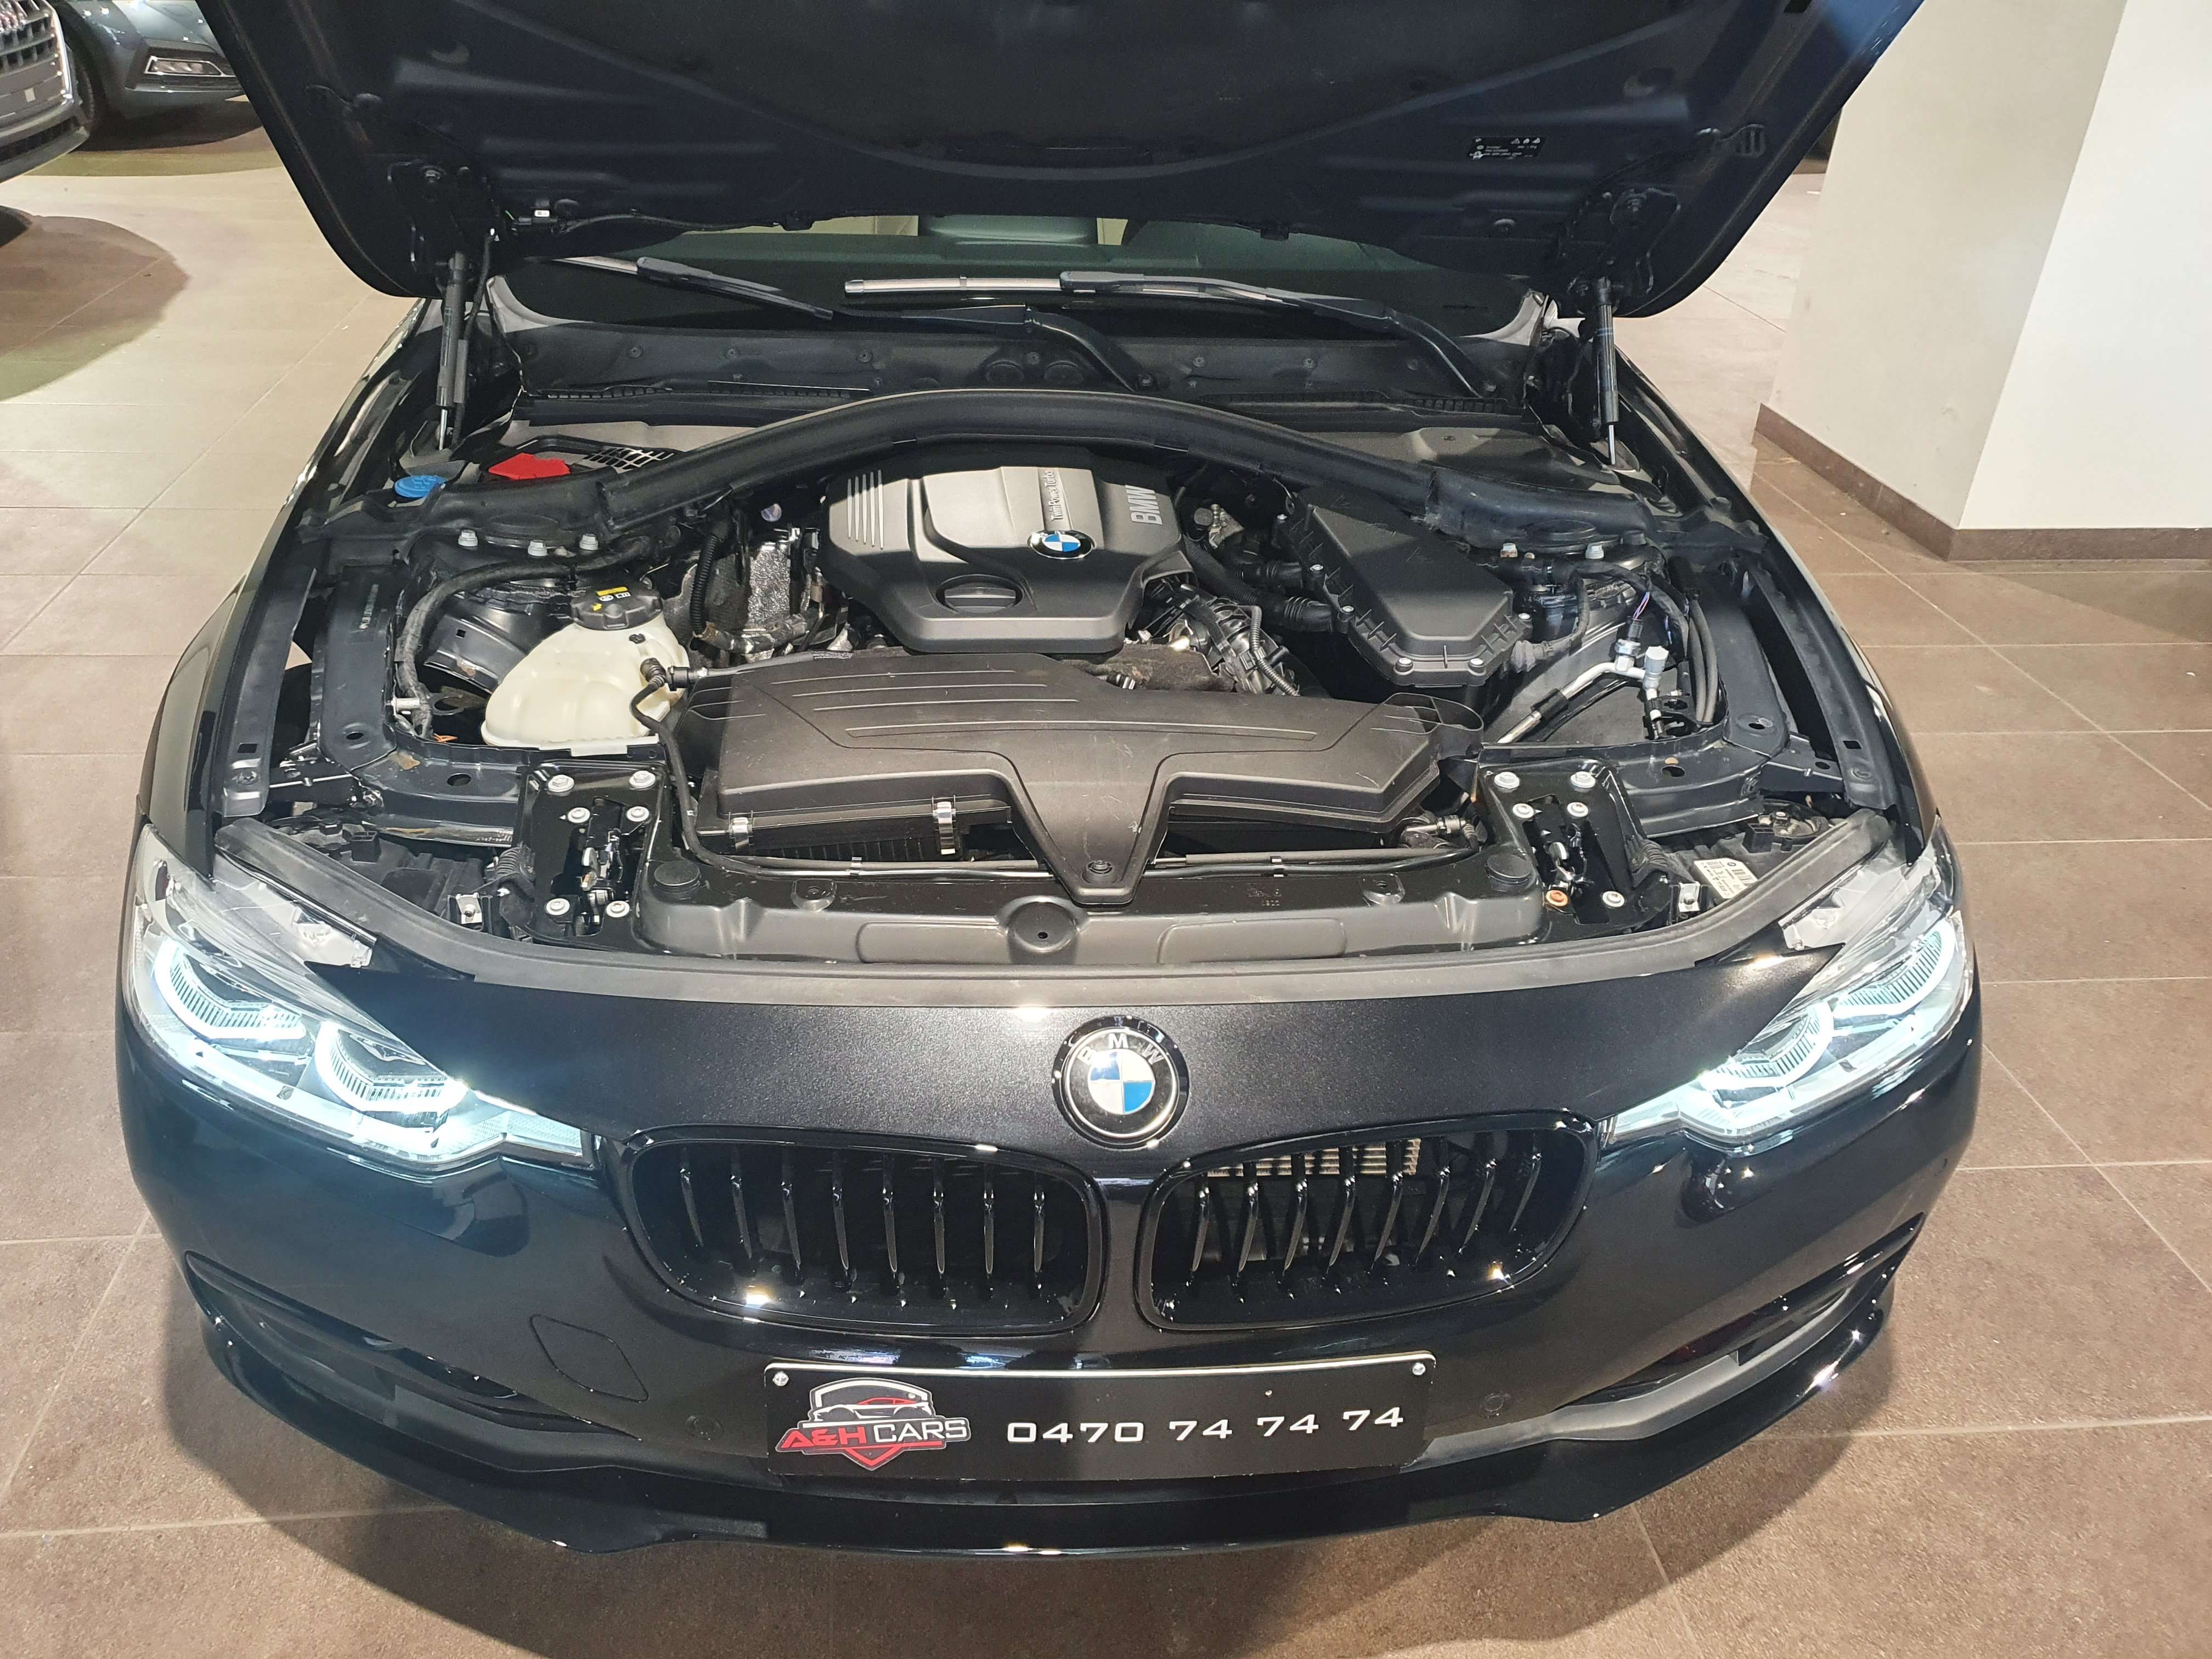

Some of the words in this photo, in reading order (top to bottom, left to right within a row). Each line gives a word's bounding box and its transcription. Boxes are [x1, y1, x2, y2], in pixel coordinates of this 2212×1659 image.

[1125, 485, 1163, 524] BMW
[1077, 1033, 1164, 1065] BMW
[781, 1427, 867, 1448] A&H
[873, 1420, 967, 1442] CARS
[1007, 1423, 1144, 1443] 0470
[1169, 1419, 1232, 1441] 74
[1257, 1414, 1319, 1436] 74
[1342, 1407, 1403, 1430] 74
